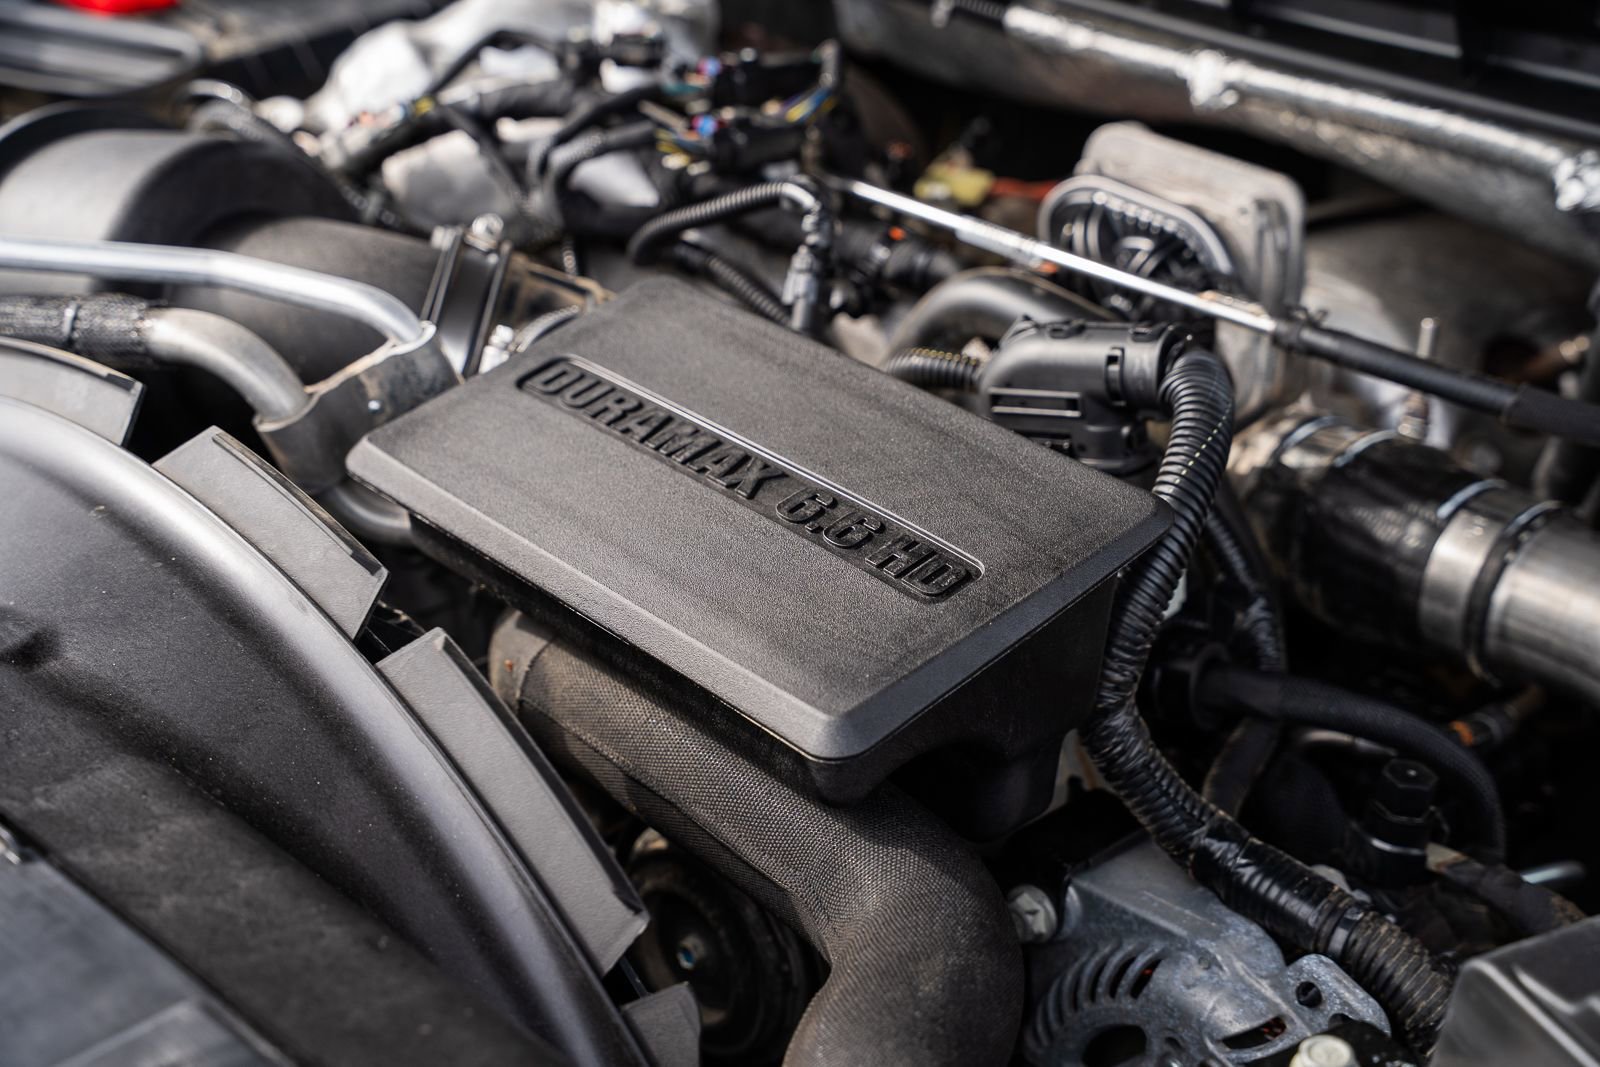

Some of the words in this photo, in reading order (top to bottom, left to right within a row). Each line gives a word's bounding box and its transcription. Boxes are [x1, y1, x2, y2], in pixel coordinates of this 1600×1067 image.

[531, 360, 789, 500] DURAMAX
[776, 488, 884, 549] 6.6
[865, 533, 972, 597] HD
